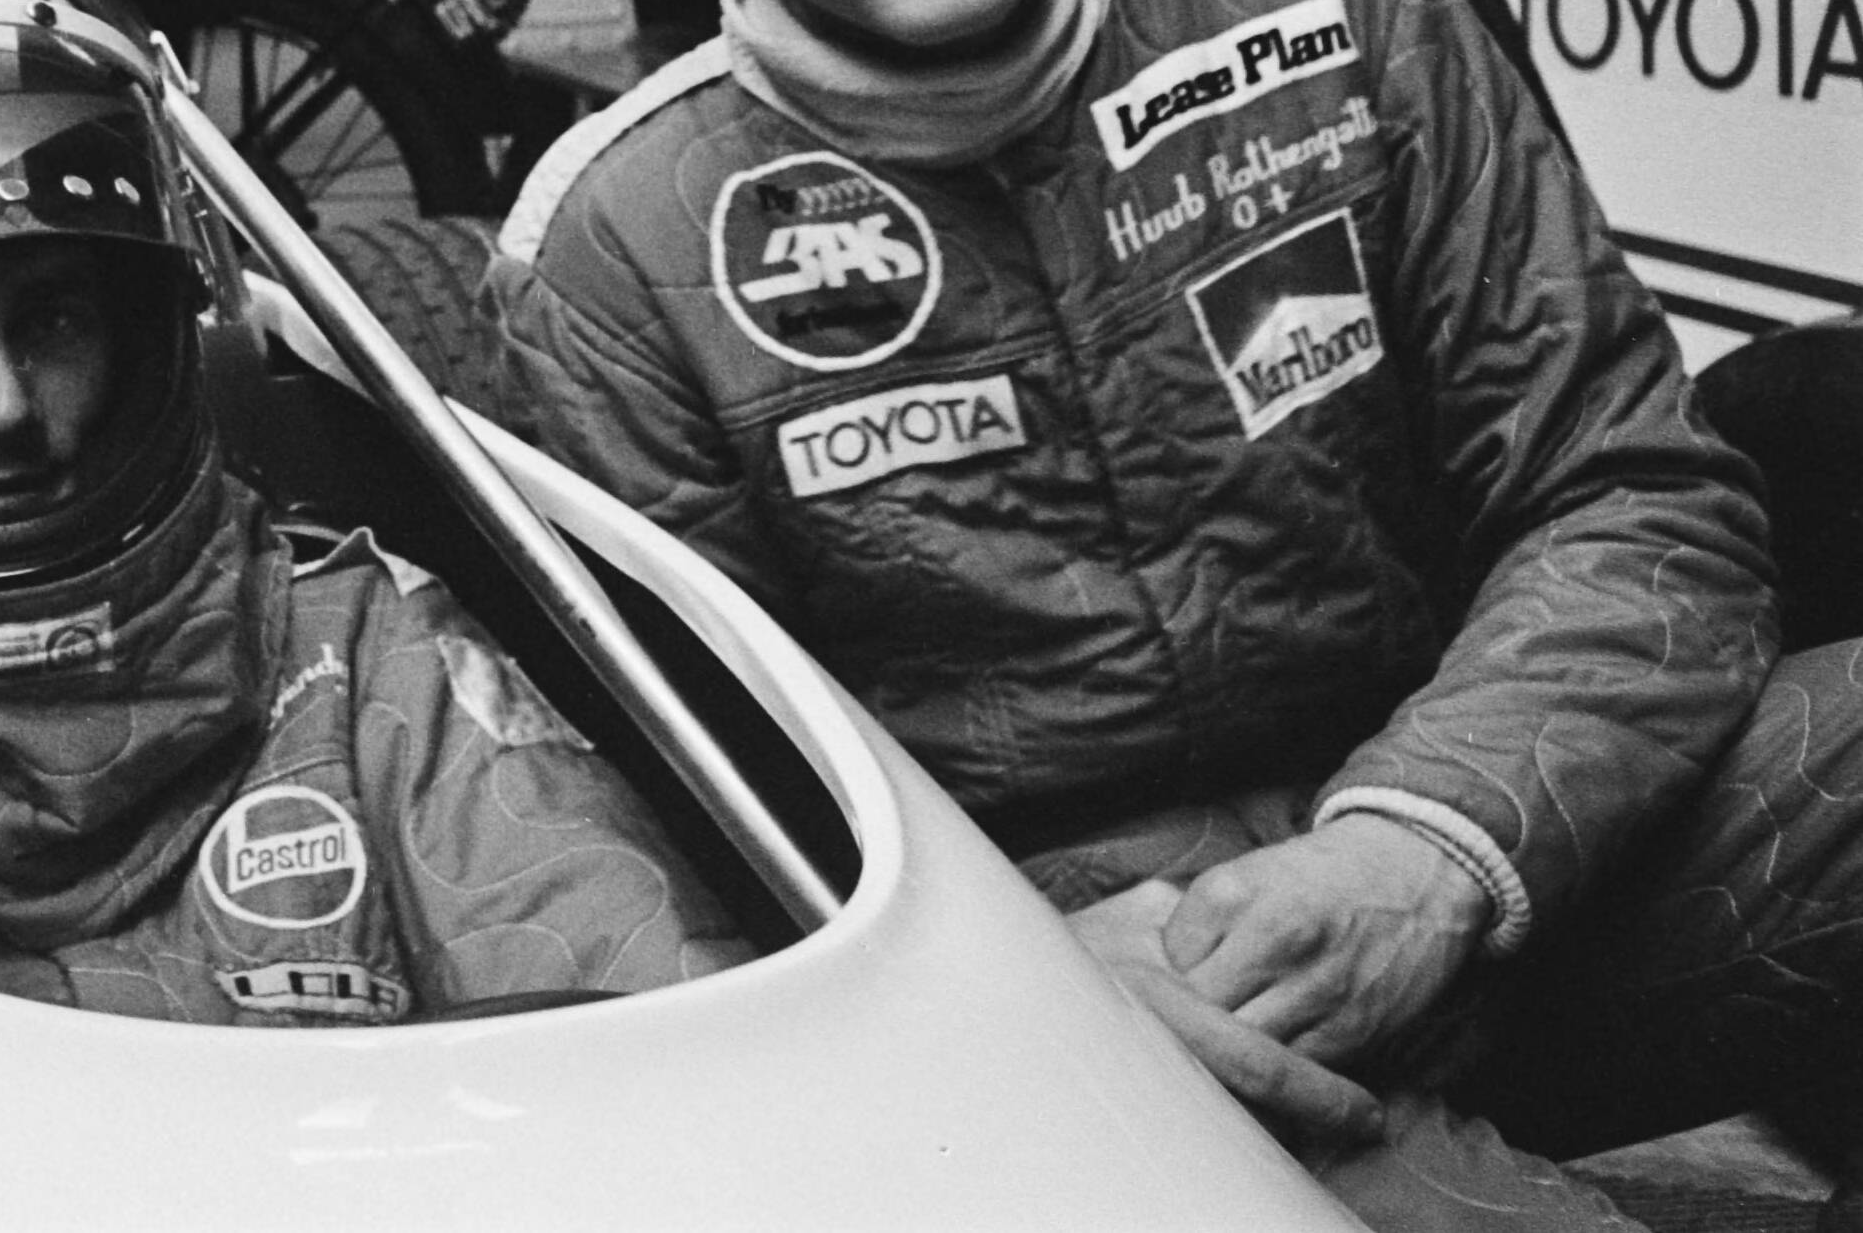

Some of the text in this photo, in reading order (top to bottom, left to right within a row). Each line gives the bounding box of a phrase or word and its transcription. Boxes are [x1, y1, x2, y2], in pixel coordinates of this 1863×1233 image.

[1116, 22, 1350, 149] Lease Plan
[1104, 173, 1206, 260] Huub
[1236, 318, 1372, 414] Marlboro
[789, 395, 1014, 477] TOYOTA
[237, 826, 346, 881] Castrol
